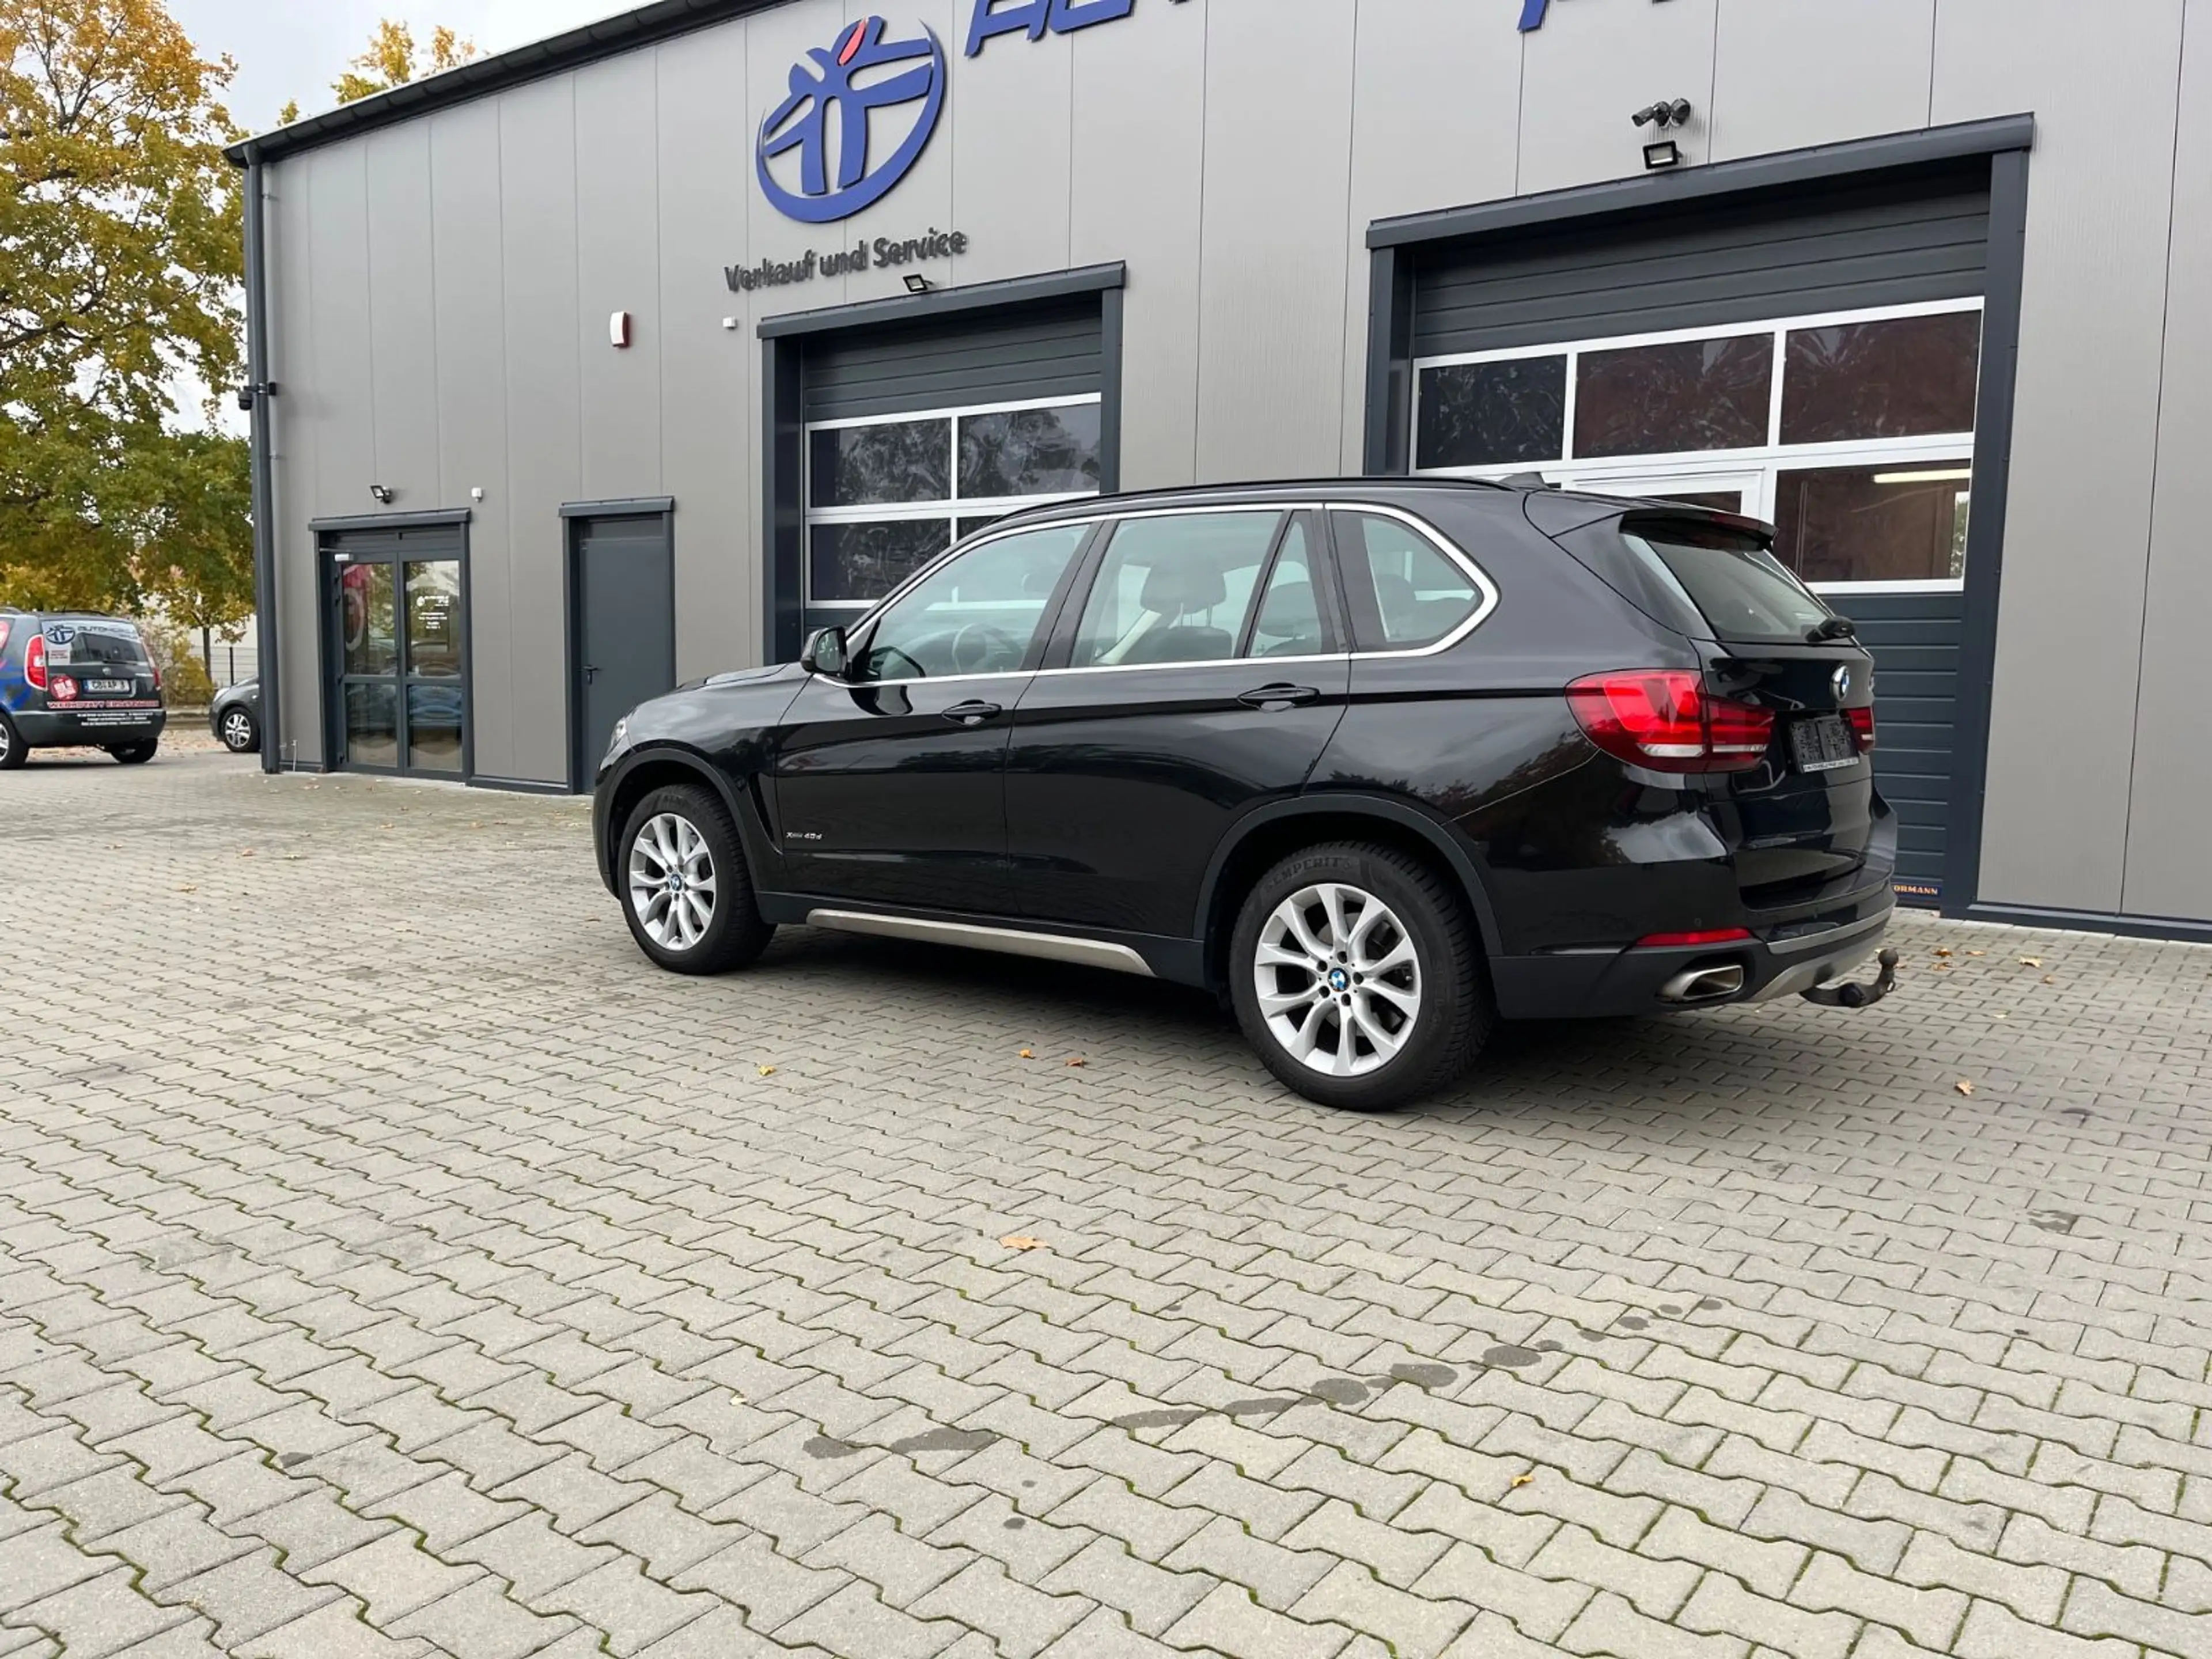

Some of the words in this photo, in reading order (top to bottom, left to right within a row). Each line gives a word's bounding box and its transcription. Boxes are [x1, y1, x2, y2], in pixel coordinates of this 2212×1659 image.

[724, 249, 814, 293] Verkauf
[819, 240, 868, 277] und
[873, 227, 967, 267] Service
[1893, 884, 1938, 895] ORMANN
